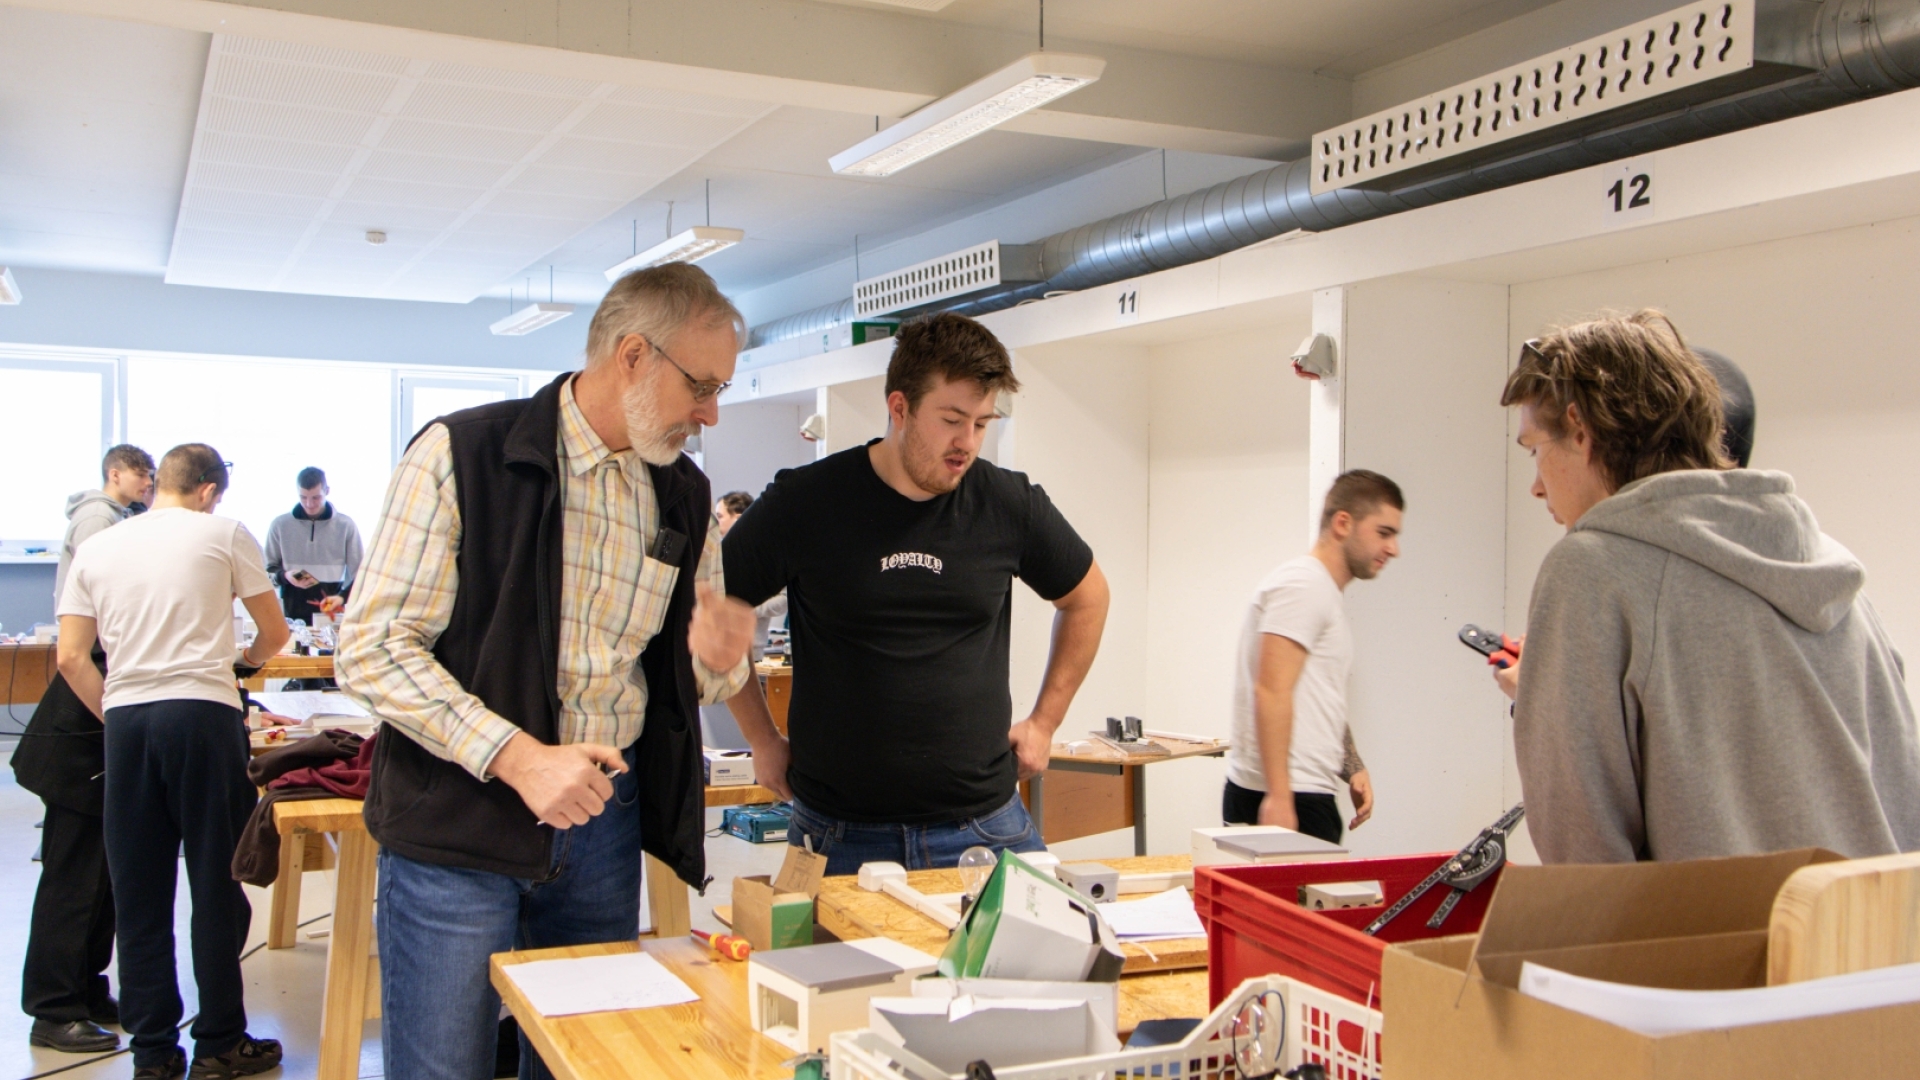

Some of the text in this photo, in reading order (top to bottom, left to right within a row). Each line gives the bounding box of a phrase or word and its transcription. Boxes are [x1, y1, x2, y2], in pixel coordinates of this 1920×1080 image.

[1607, 173, 1650, 212] 12
[1118, 290, 1136, 314] 11
[880, 552, 943, 575] LOYALTY
